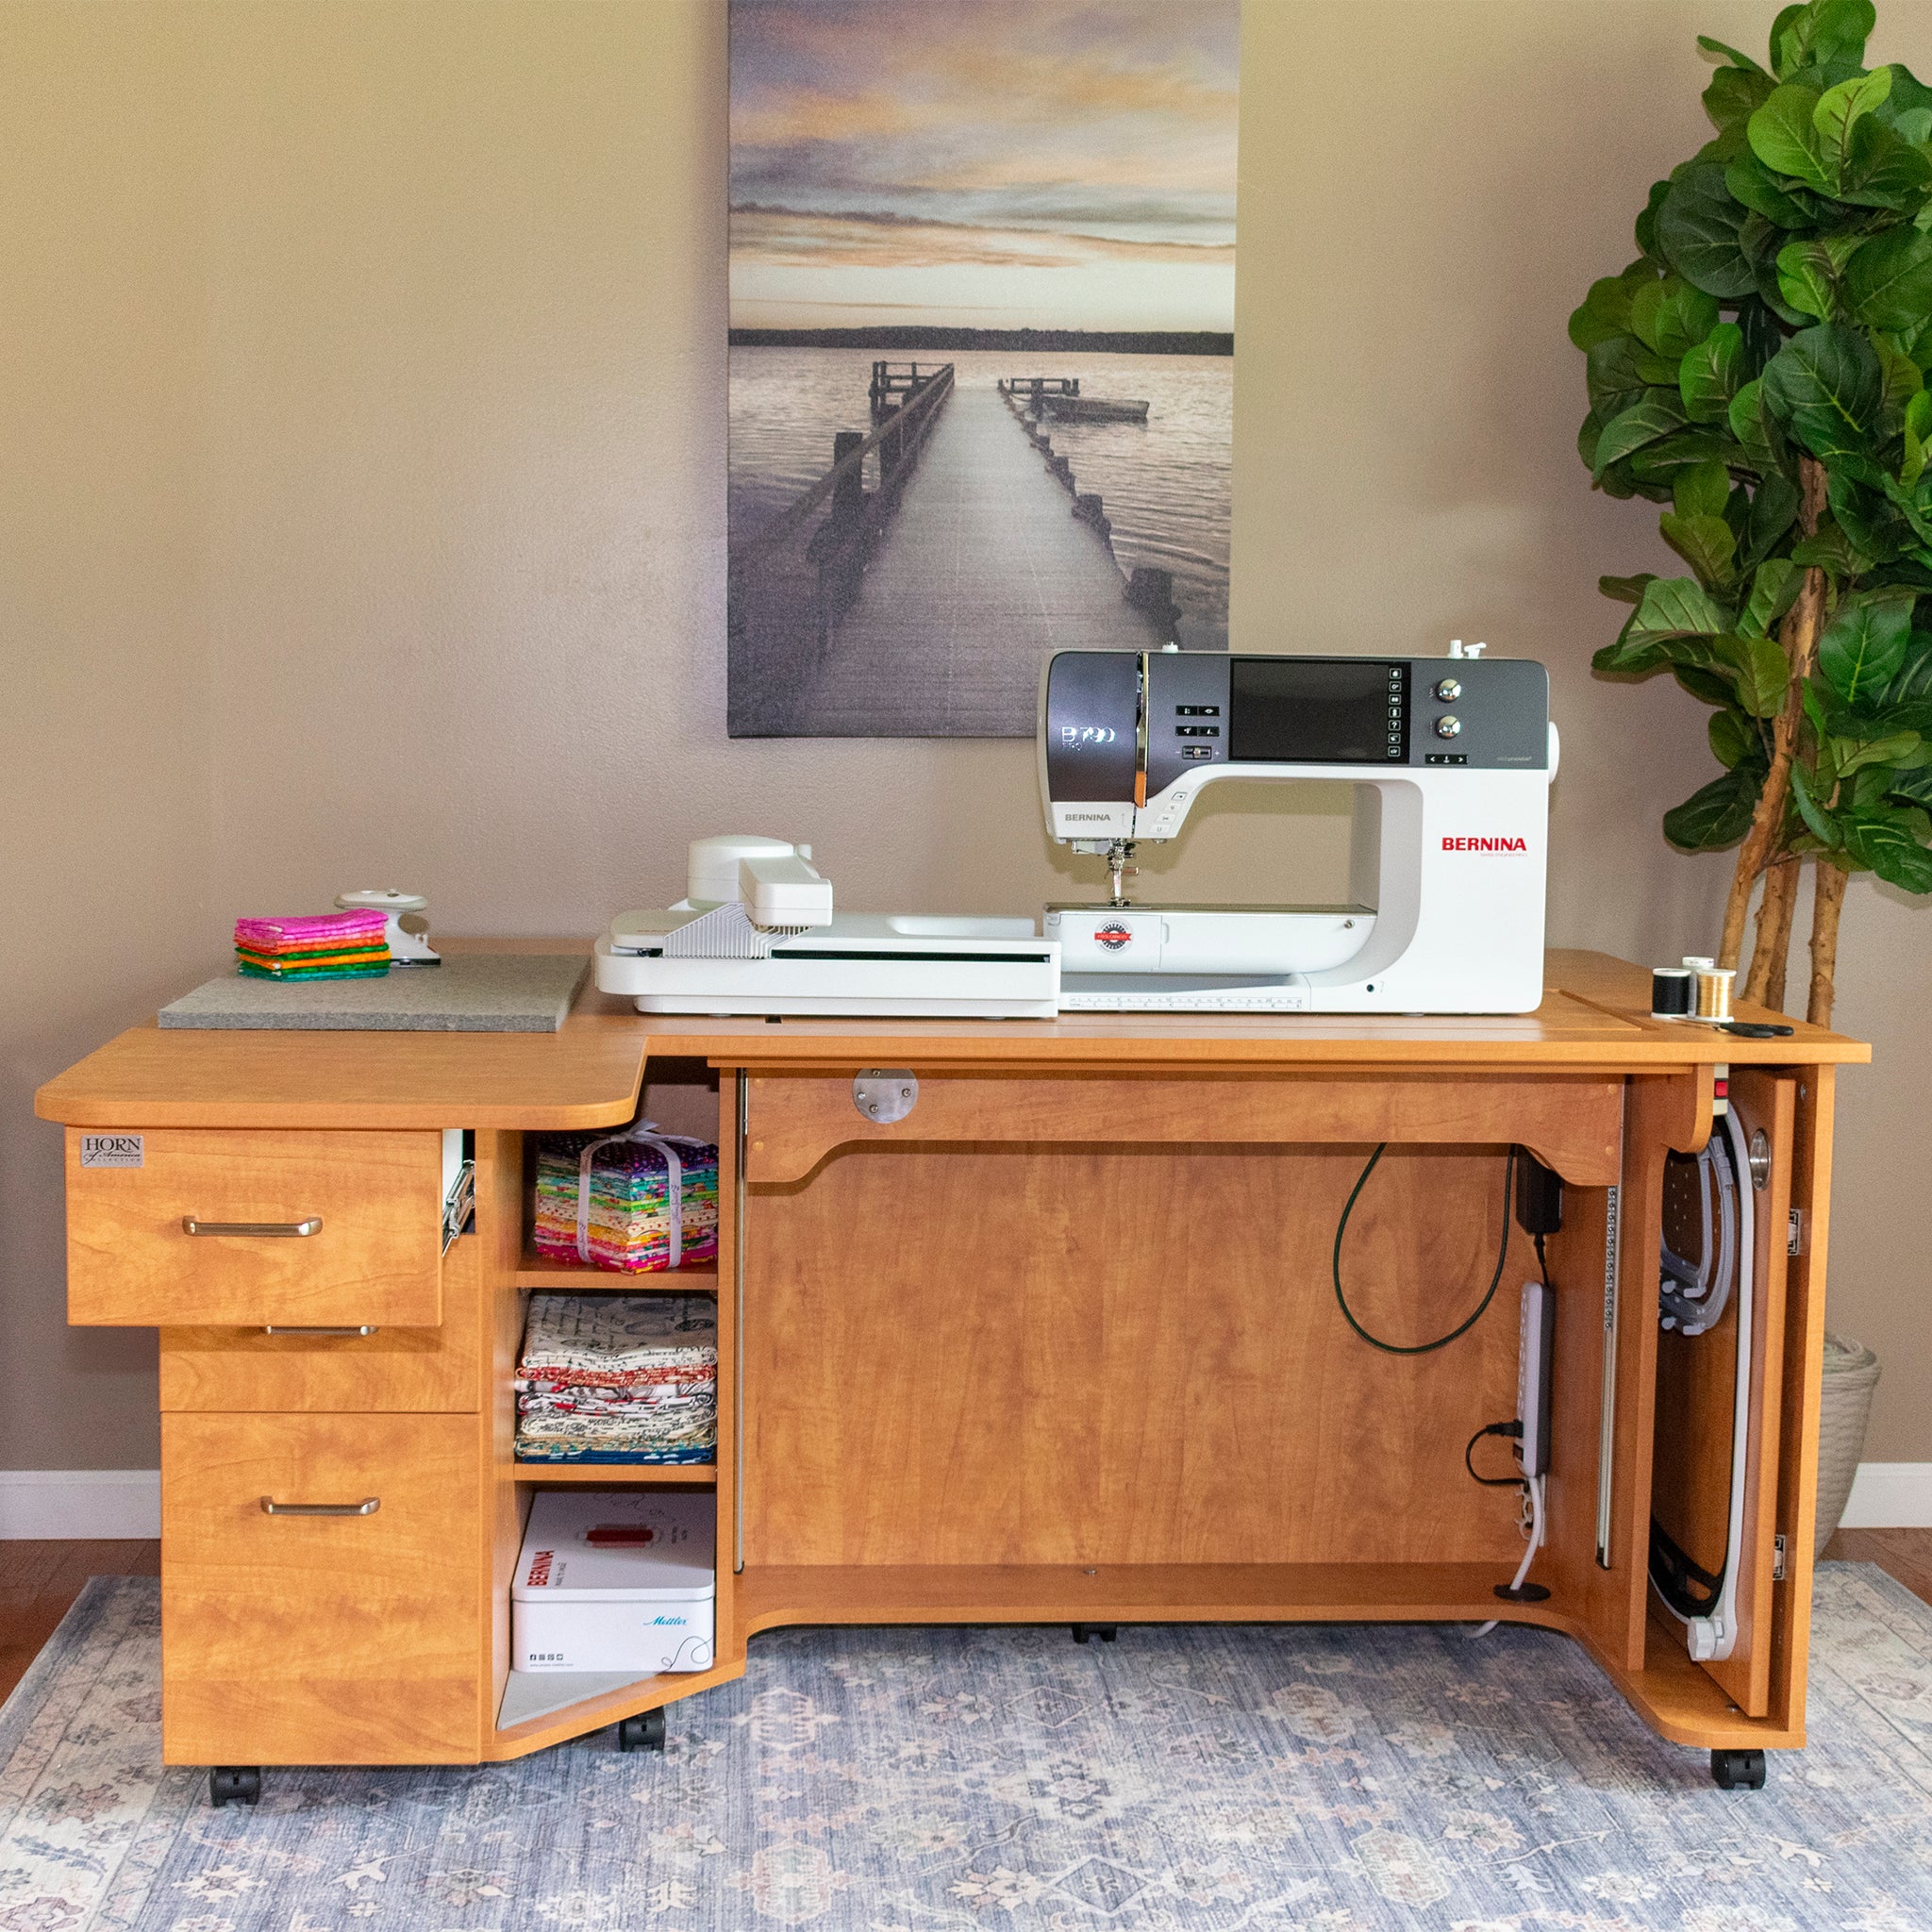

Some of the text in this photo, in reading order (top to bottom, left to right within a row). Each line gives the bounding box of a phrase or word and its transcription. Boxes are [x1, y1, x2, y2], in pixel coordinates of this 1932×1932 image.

[1065, 813, 1111, 822] BERNINA
[1441, 837, 1527, 851] BERNINA
[86, 1138, 141, 1153] HORN
[526, 1550, 555, 1587] BERNINA
[642, 1615, 688, 1626] Mettler
